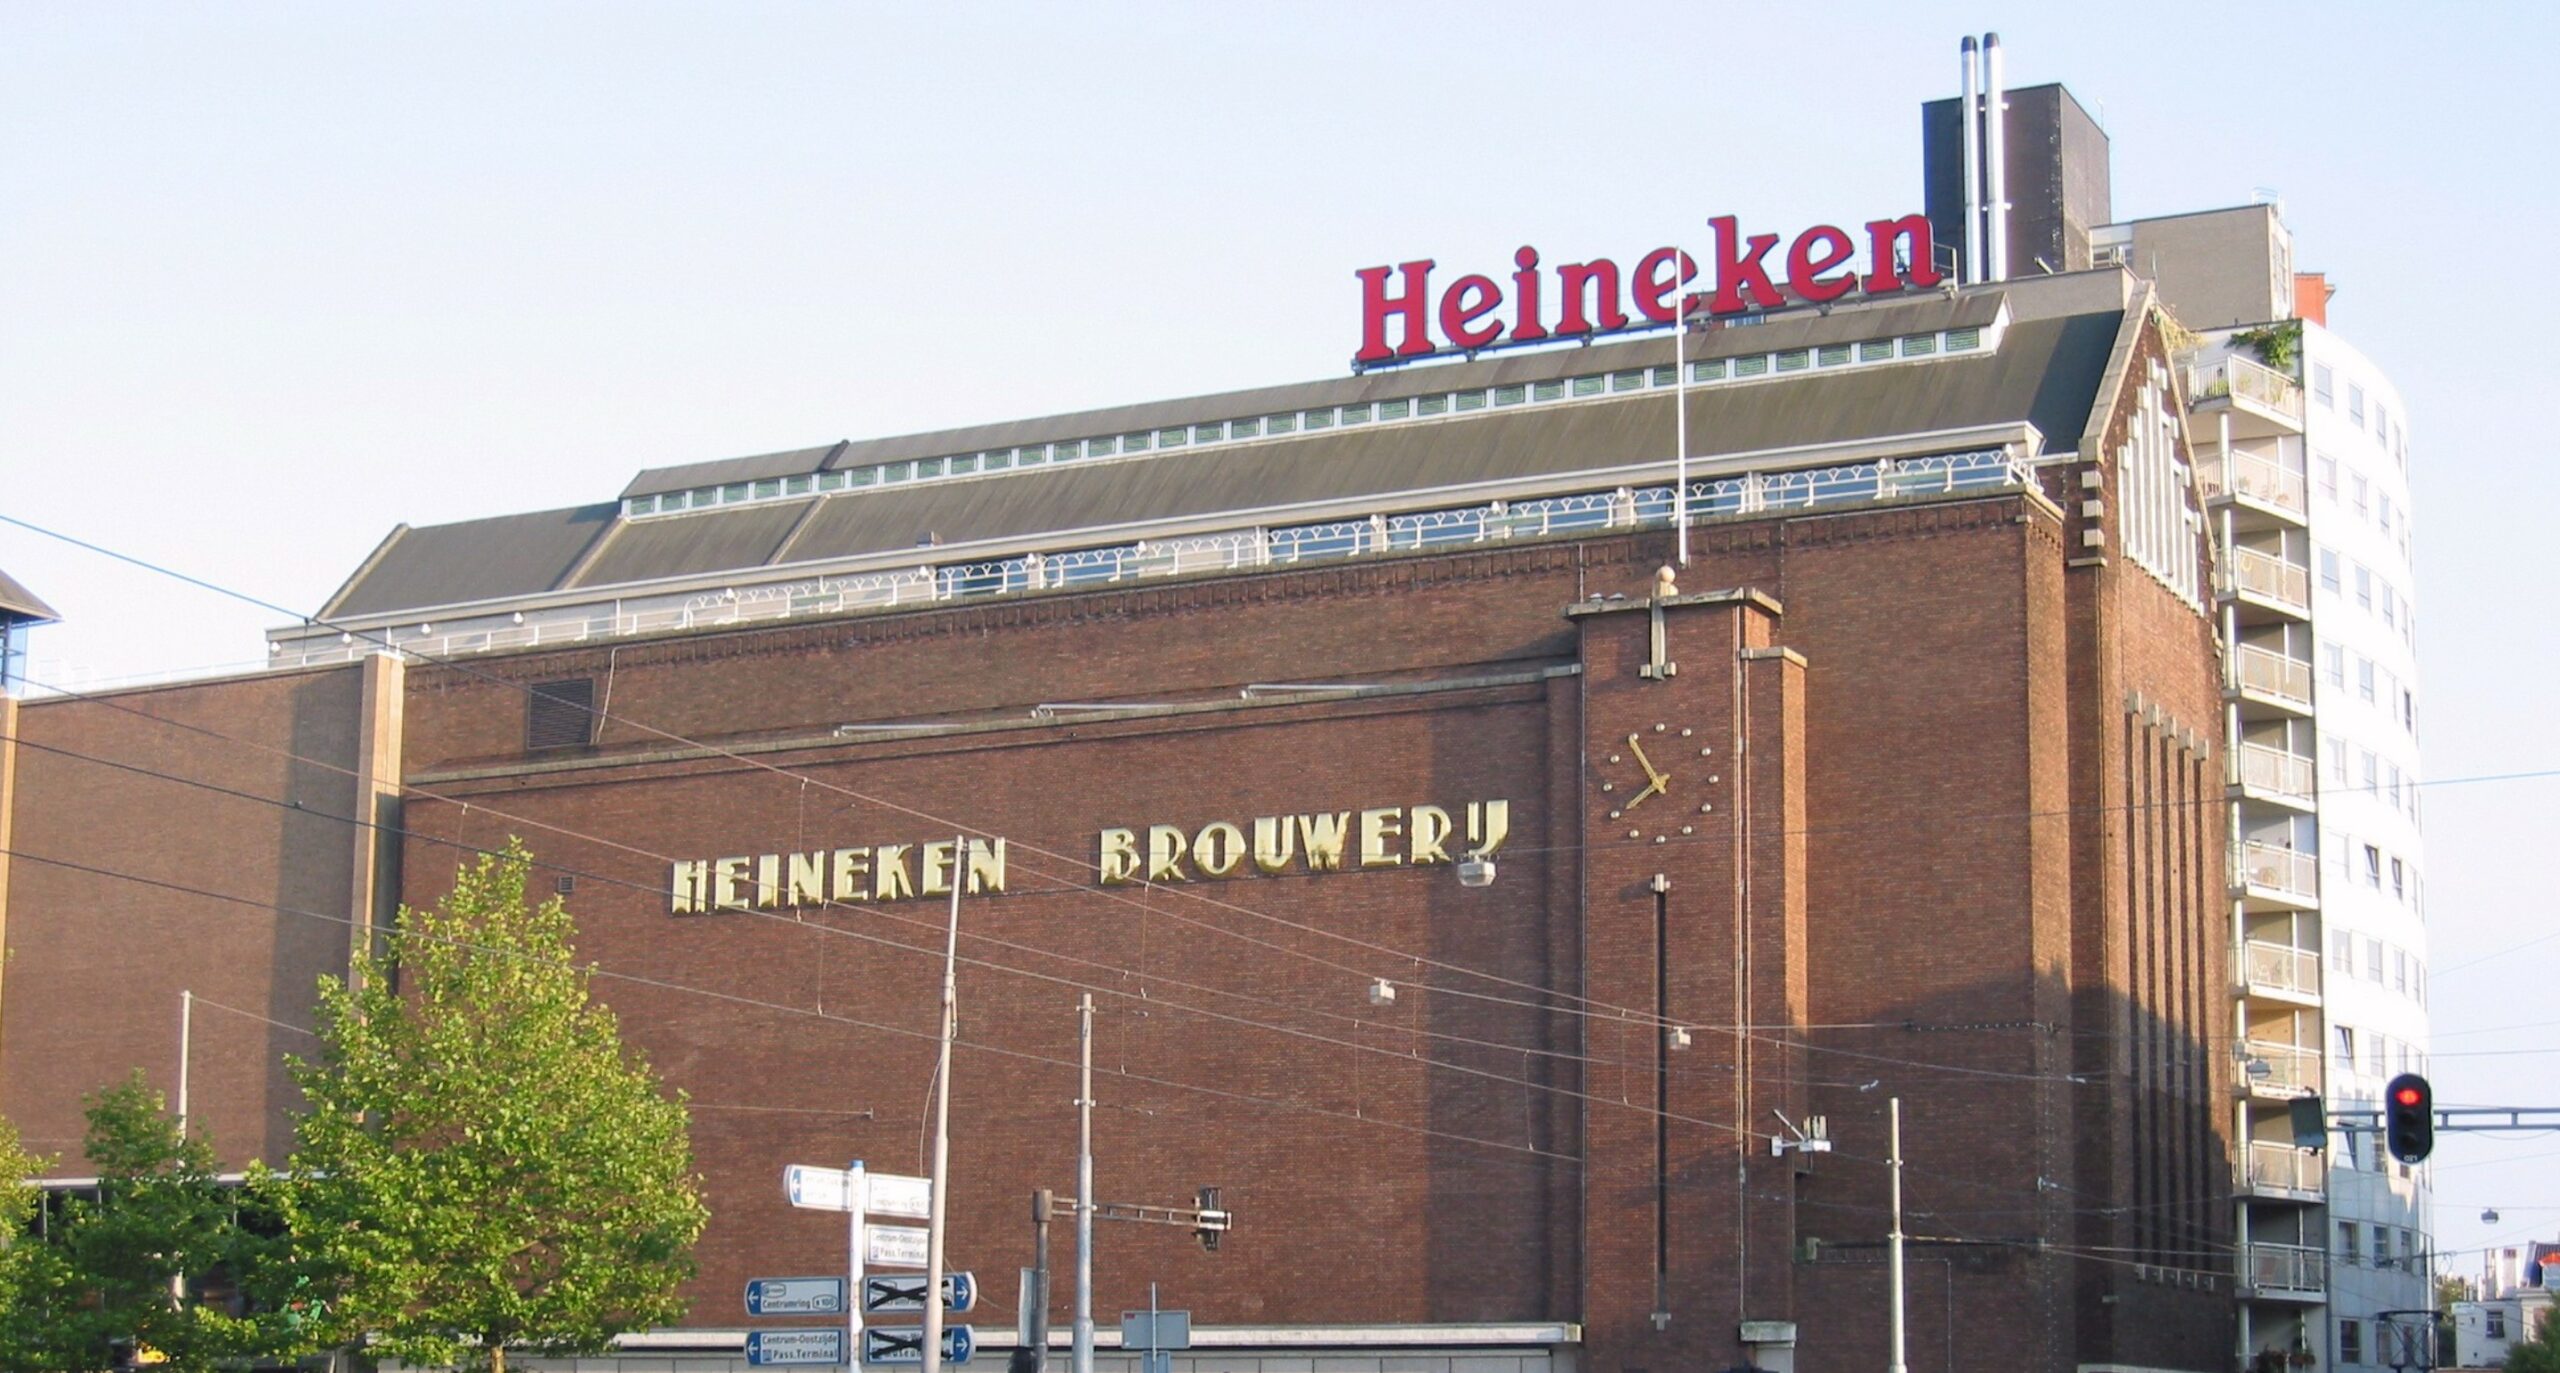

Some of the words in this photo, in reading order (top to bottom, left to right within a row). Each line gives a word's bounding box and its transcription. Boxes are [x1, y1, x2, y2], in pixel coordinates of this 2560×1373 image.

[1354, 213, 1943, 362] Heineken
[672, 836, 1006, 914] HEINEKEN
[1100, 799, 1509, 885] BROUWERIJ
